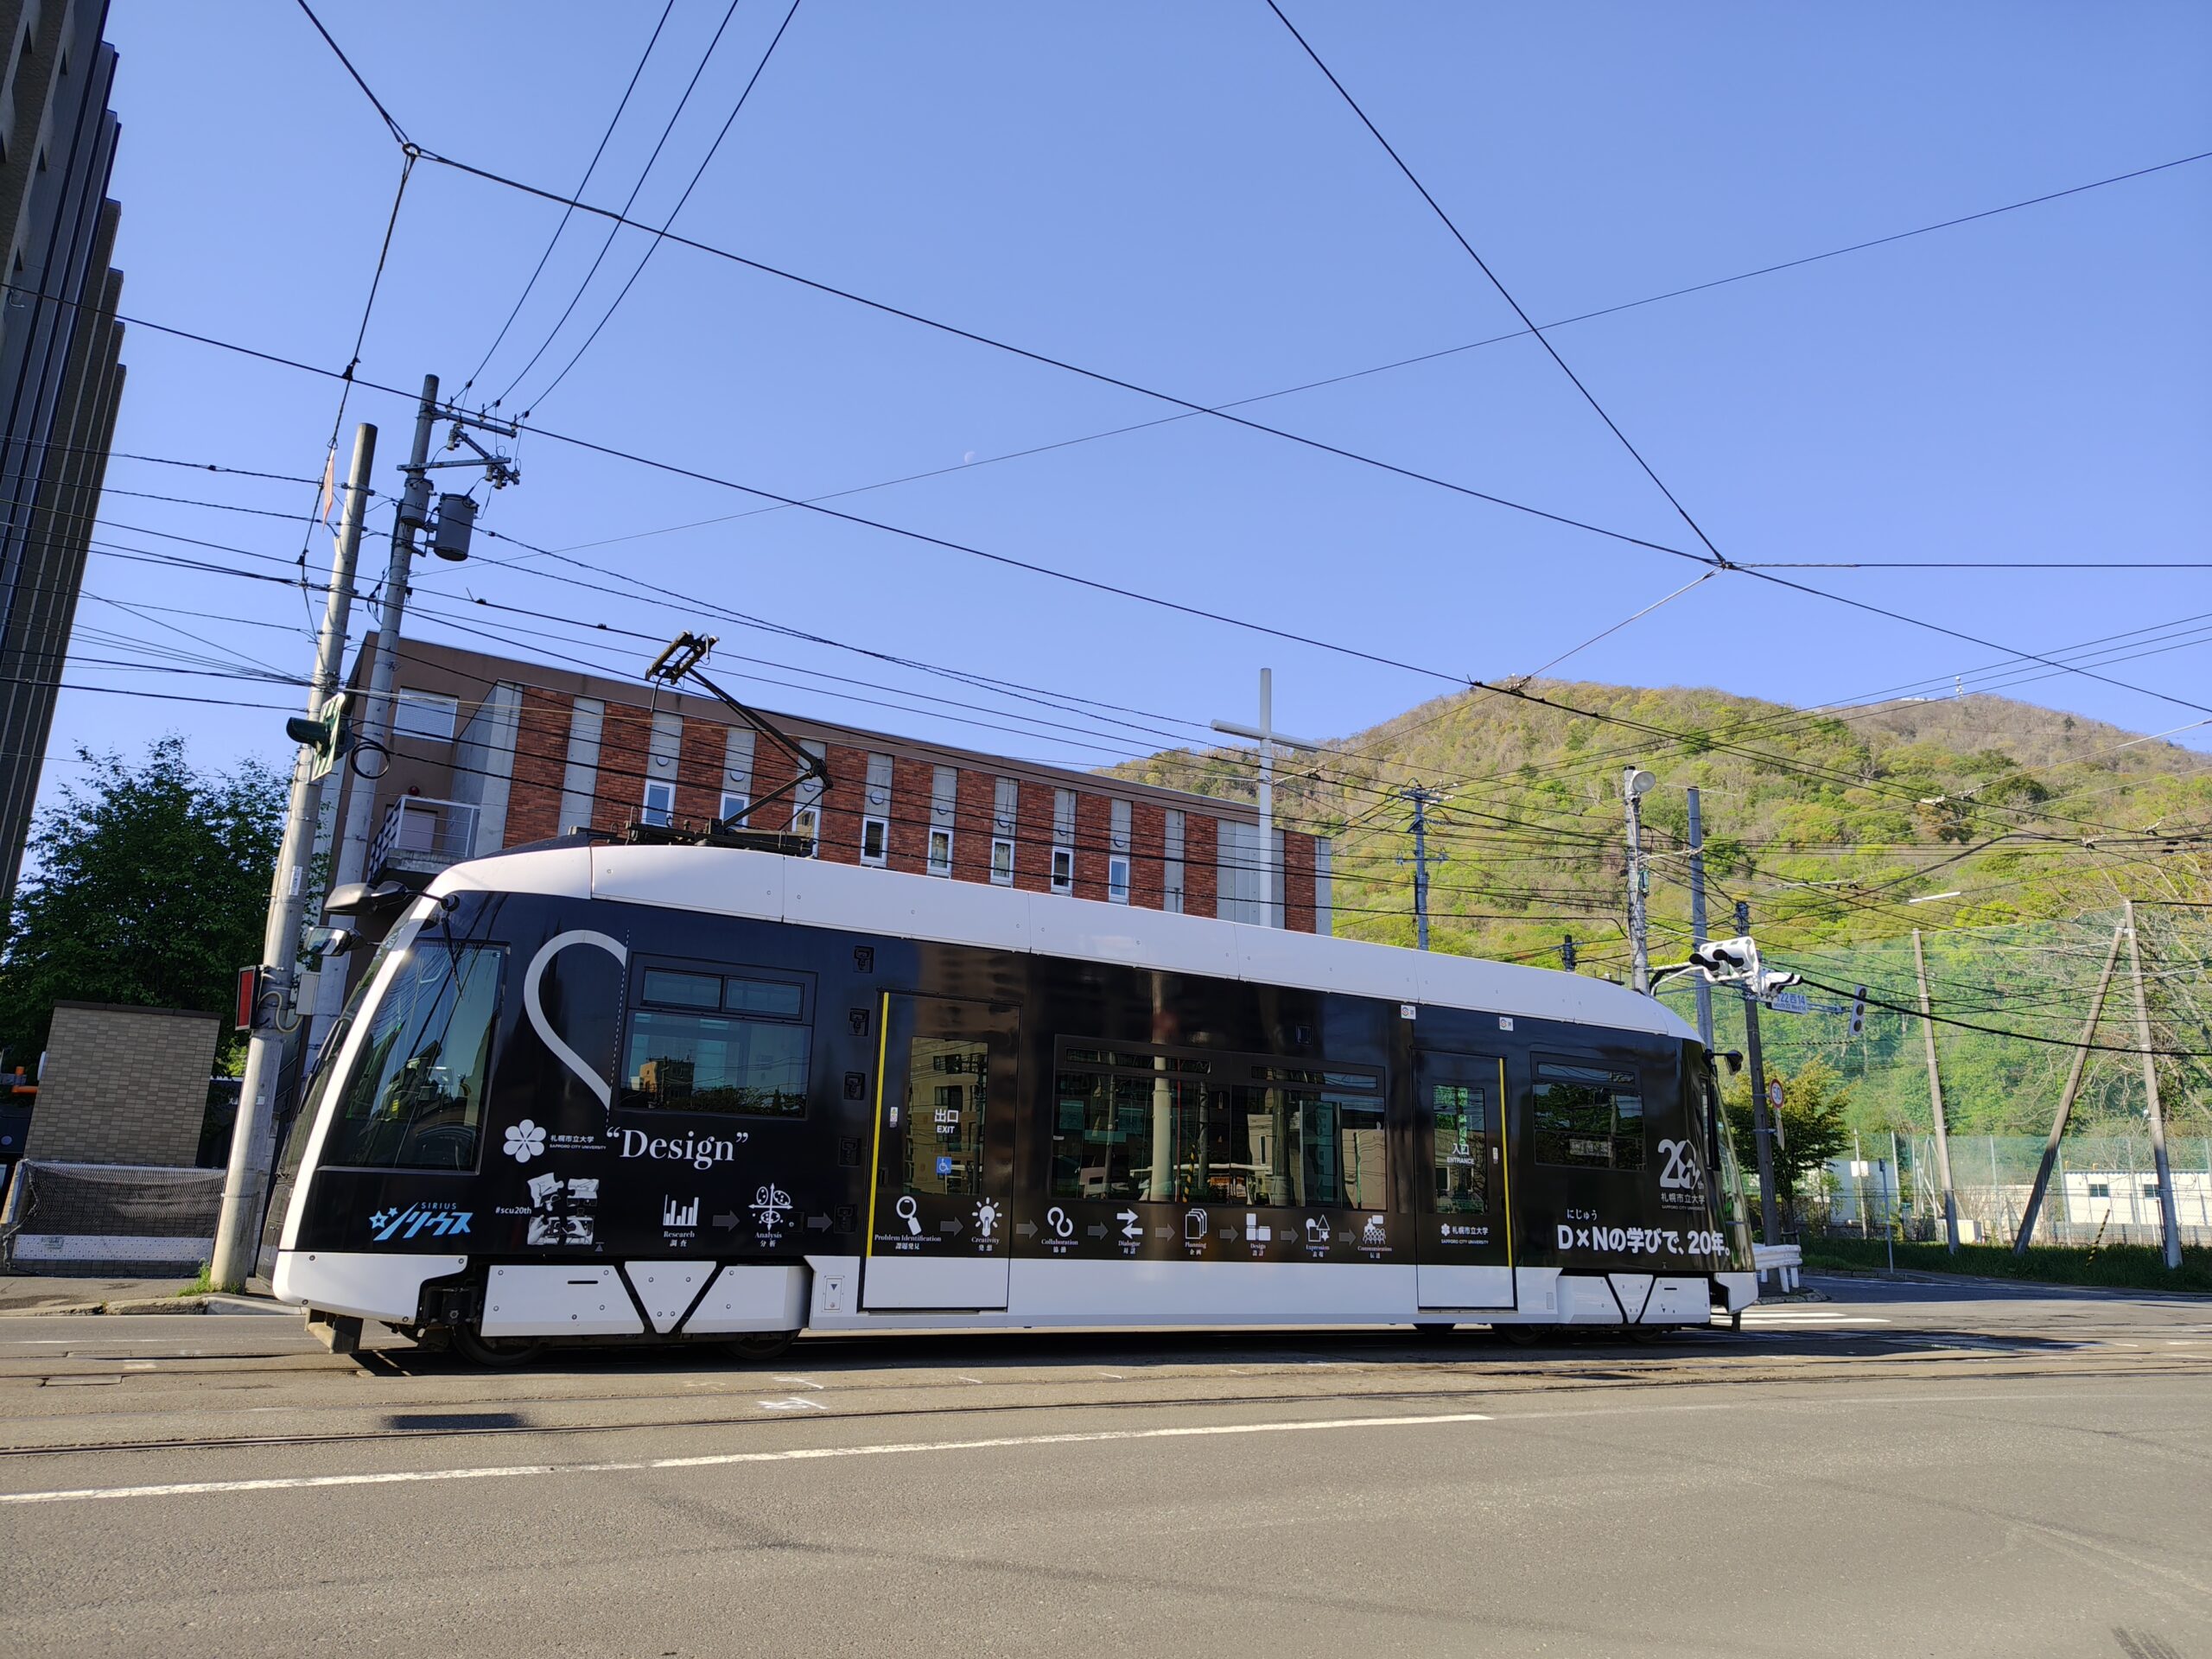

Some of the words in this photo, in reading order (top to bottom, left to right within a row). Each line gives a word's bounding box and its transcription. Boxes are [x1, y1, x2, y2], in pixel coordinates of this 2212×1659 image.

[1772, 1086, 1782, 1100] 50
[934, 1109, 959, 1122] 出口
[937, 1125, 956, 1134] EXIT
[550, 1135, 594, 1143] 札幌市立大学
[1452, 1142, 1470, 1155] 入口
[1446, 1156, 1475, 1165] ENTRANCE
[1661, 1192, 1706, 1205] 札幌市立大学
[495, 1206, 532, 1215] #scu20th
[1567, 1209, 1598, 1221] にじゅう
[369, 1202, 474, 1241] シリウス
[754, 1231, 783, 1240] Analysis
[1452, 1225, 1488, 1236] 札幌市立大学
[760, 1239, 776, 1248] 分析
[874, 1234, 900, 1243] Problem
